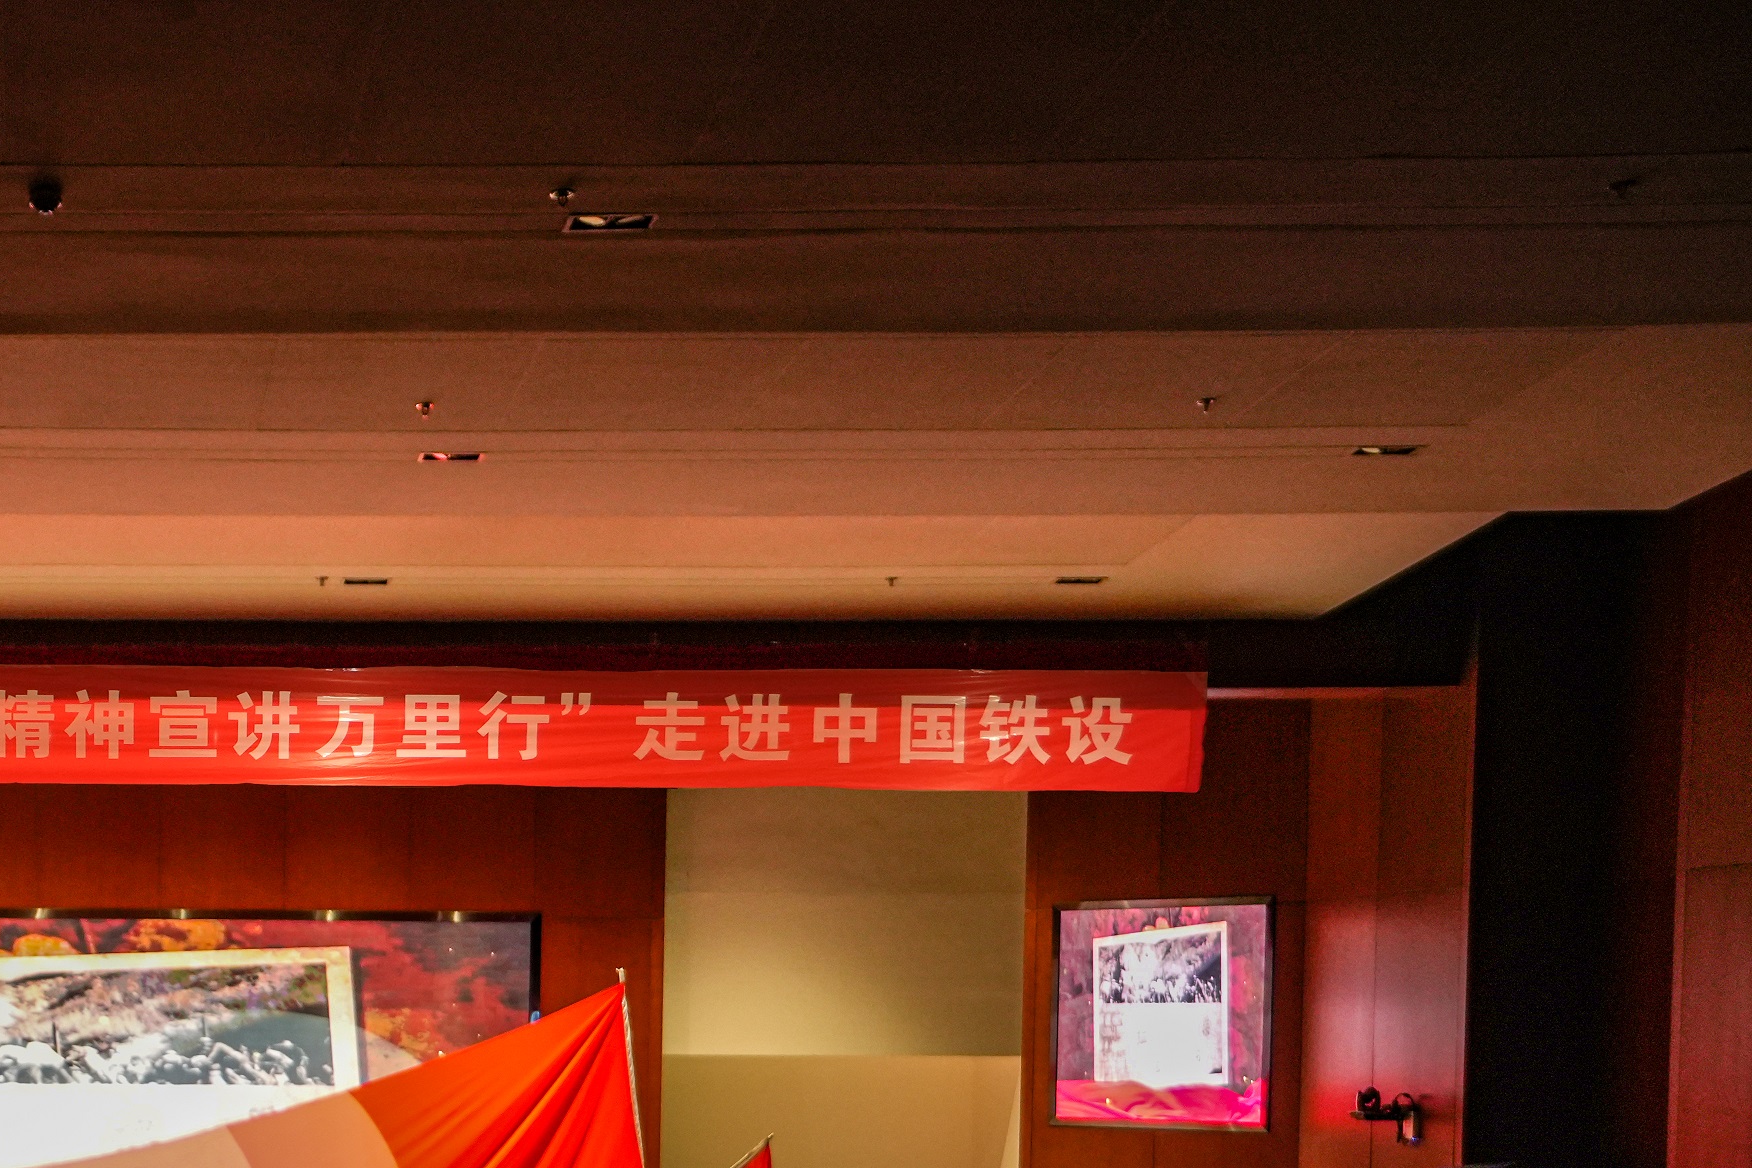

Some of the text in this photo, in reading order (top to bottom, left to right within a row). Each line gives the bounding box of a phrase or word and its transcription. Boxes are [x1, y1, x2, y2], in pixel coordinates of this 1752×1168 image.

[633, 691, 1134, 766] 走进中国铁设
